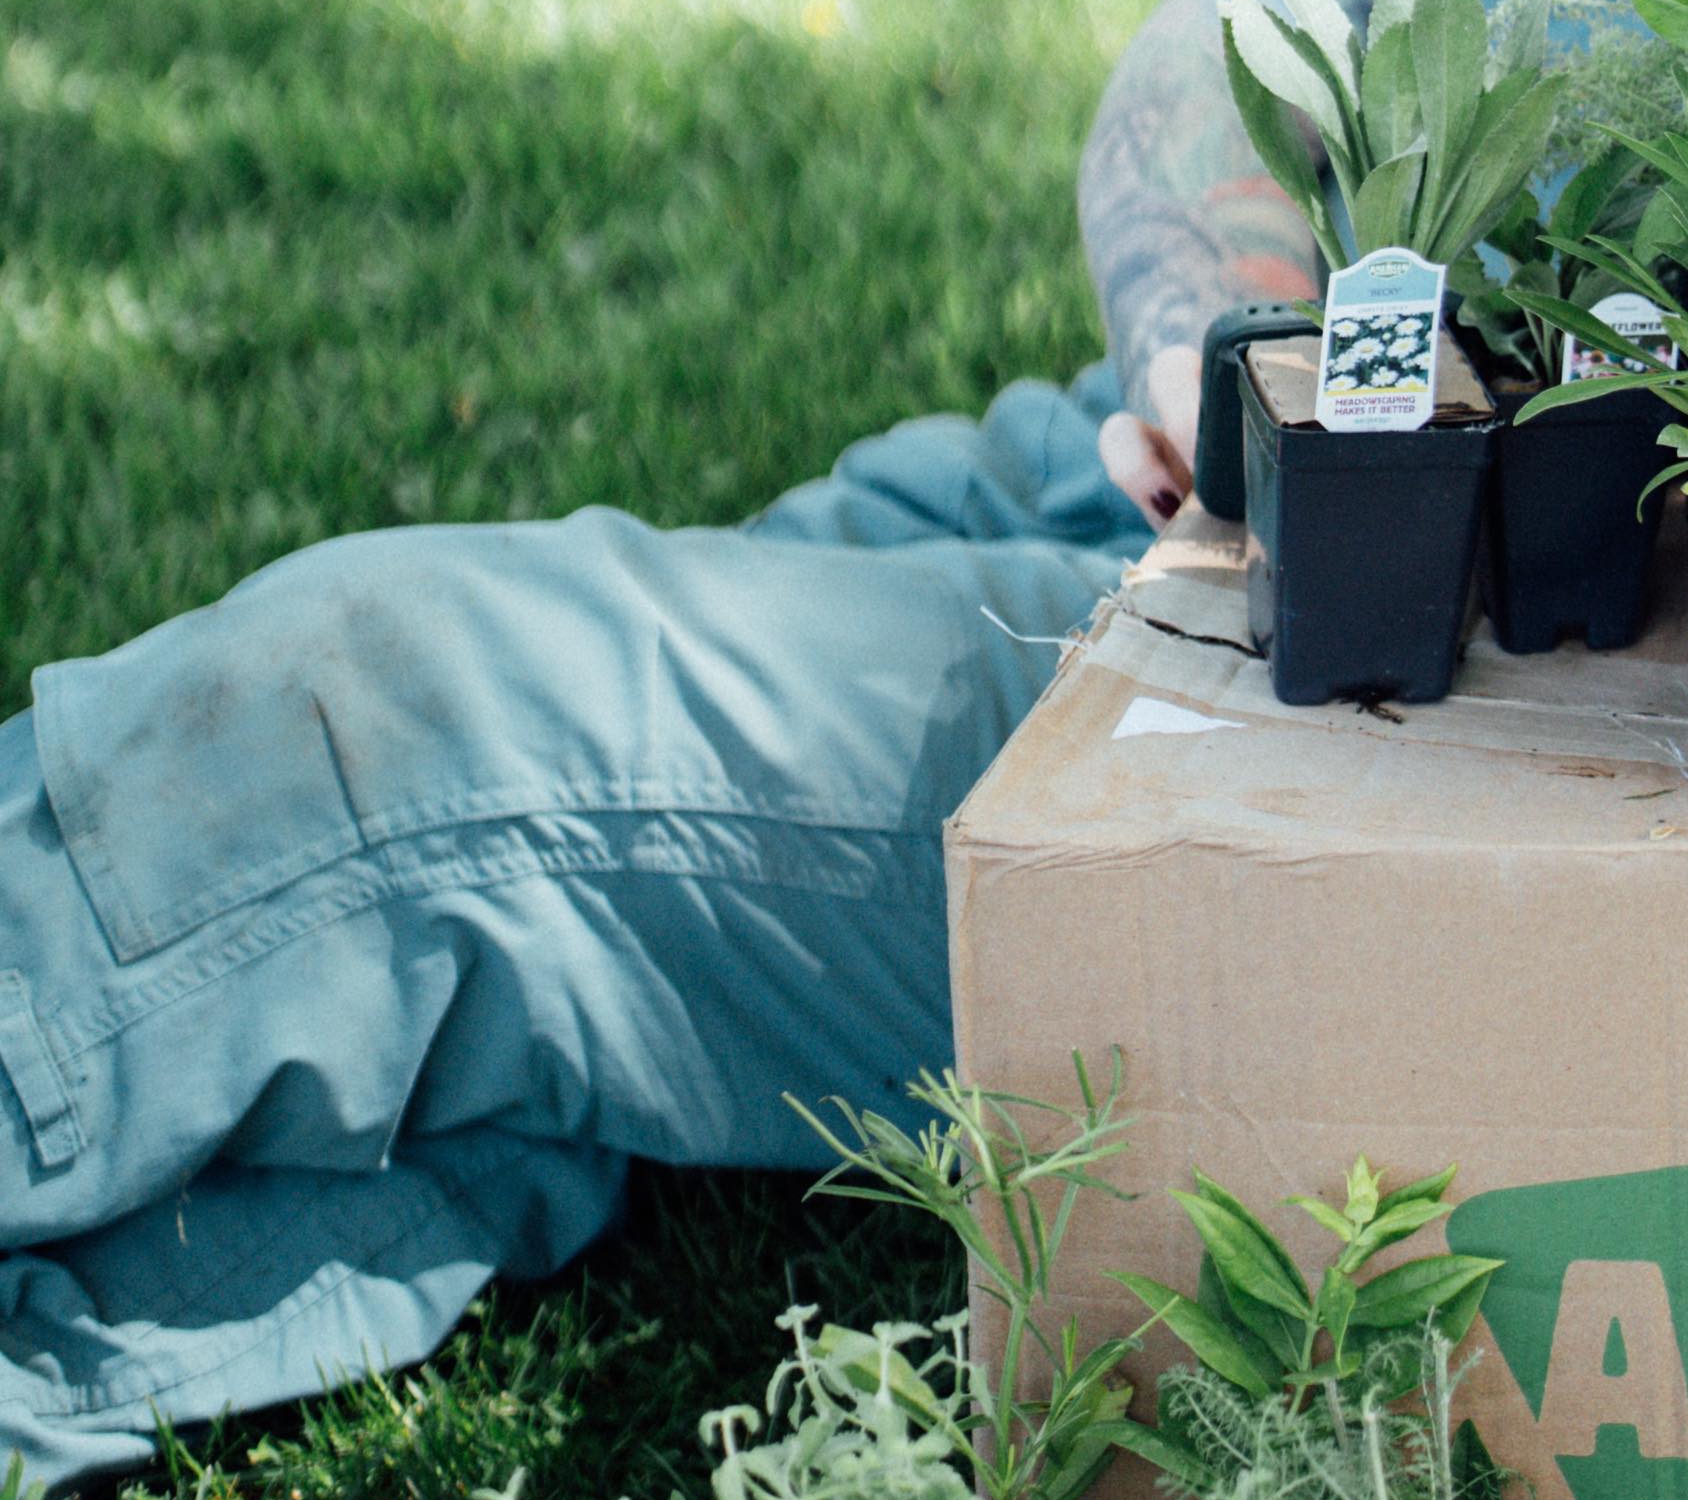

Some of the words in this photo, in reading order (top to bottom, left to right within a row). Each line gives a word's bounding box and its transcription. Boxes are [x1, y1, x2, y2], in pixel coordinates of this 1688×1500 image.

[1334, 395, 1416, 406] MEADOWSCAPING
[1334, 406, 1365, 416] MAKES
[1368, 405, 1377, 415] IT
[1380, 404, 1416, 414] BETTER
